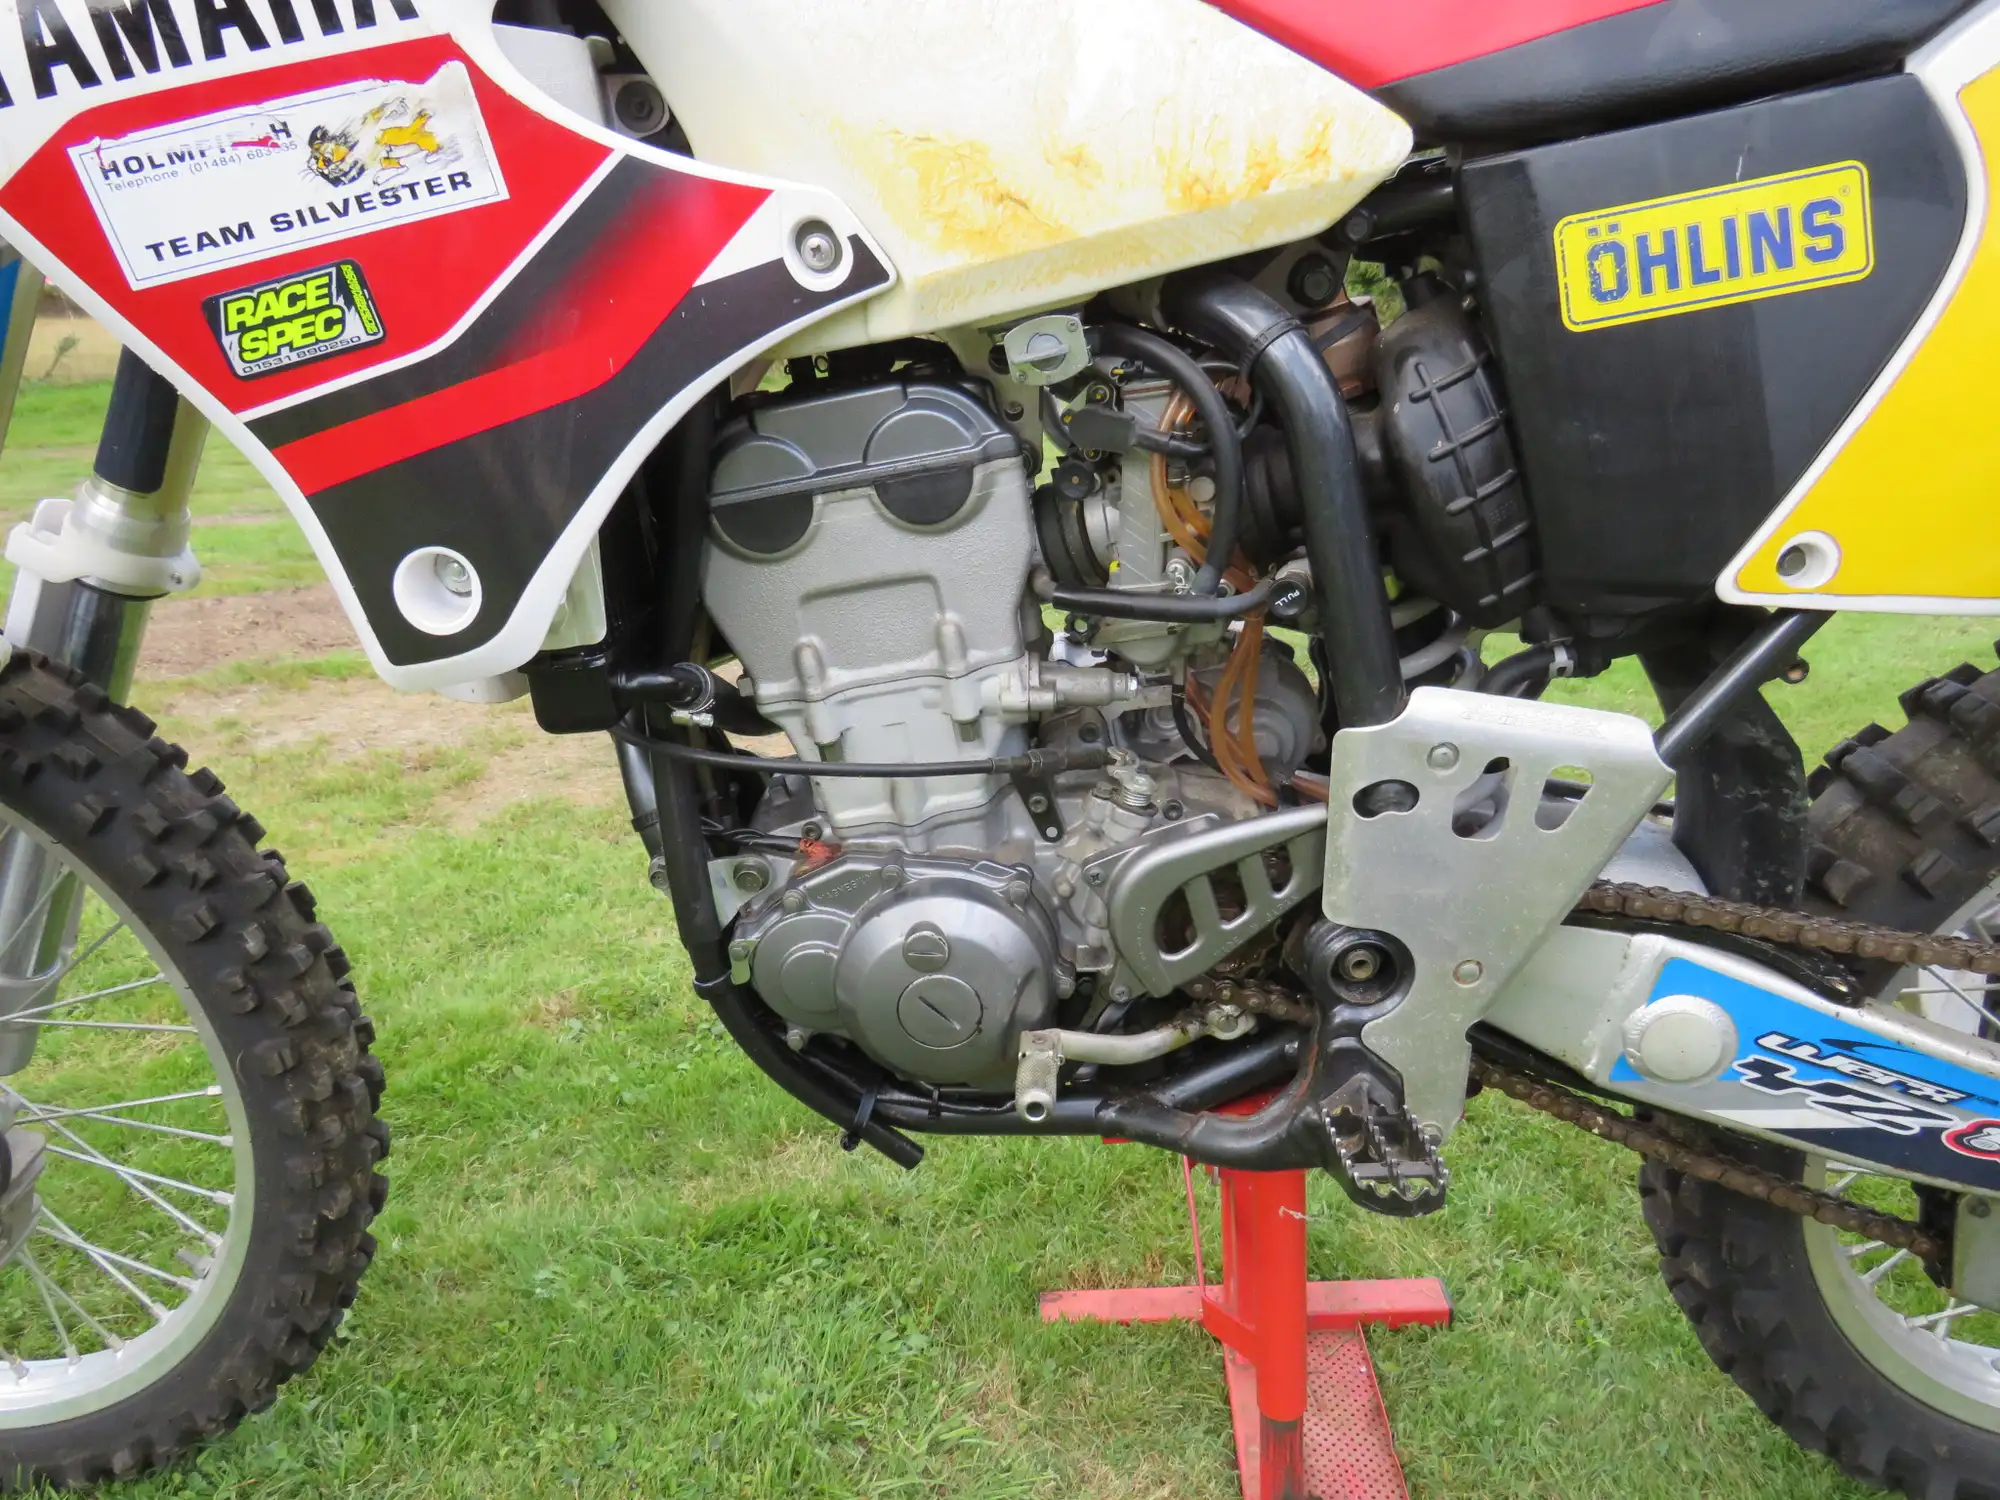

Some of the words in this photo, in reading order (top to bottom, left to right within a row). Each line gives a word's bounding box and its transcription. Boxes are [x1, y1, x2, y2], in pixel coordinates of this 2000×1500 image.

[0, 0, 420, 107] AMA
[106, 169, 179, 192] Telephone
[189, 152, 242, 176] (01484)
[247, 141, 298, 161] 68335
[145, 221, 255, 262] TEAM
[270, 171, 473, 233] SILVESTER
[1585, 195, 1845, 305] ÖHLINS
[227, 276, 330, 332] RACE
[240, 307, 343, 362] SPEC
[242, 356, 293, 374] 01531
[1274, 589, 1300, 606] PULL
